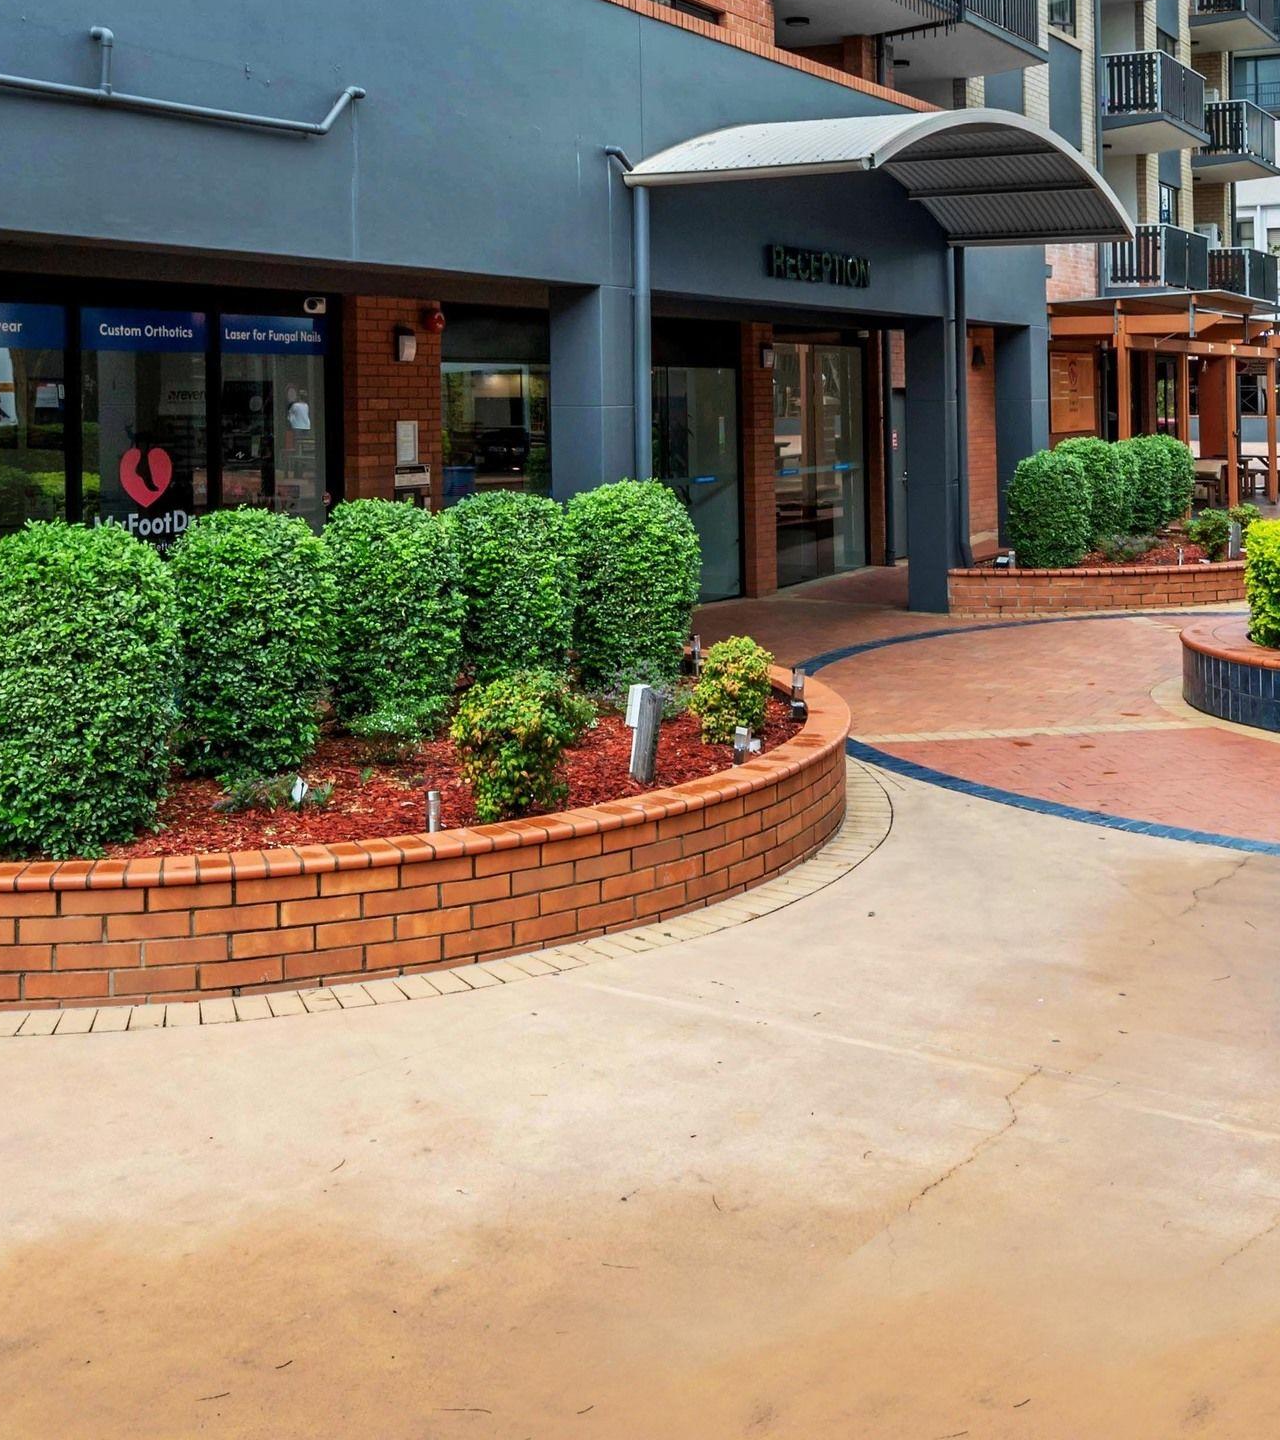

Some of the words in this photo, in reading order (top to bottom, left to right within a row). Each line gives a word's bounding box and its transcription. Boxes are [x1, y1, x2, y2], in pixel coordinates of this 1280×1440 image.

[769, 243, 871, 287] RECEPTION
[99, 323, 142, 337] Custom
[144, 324, 193, 338] Orthotics
[224, 328, 250, 340] Laser
[252, 328, 267, 341] for
[268, 329, 299, 344] Fungal
[300, 330, 322, 343] Nails
